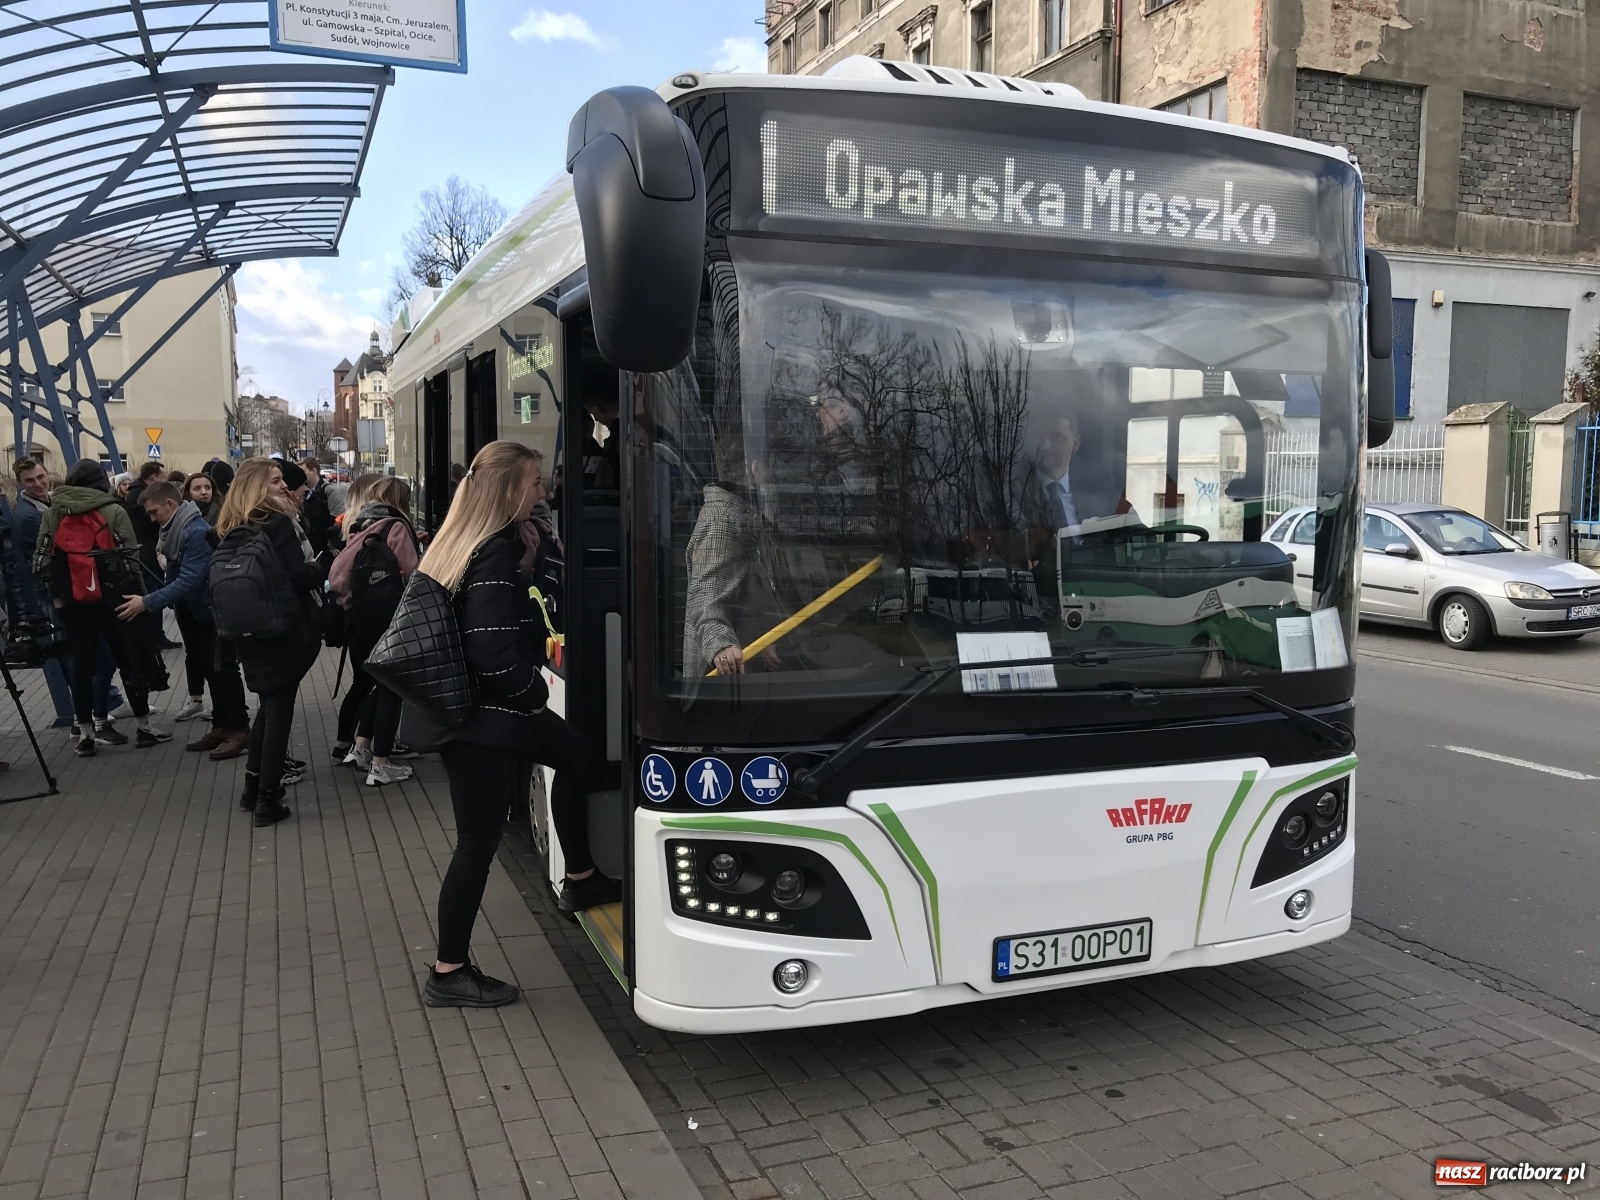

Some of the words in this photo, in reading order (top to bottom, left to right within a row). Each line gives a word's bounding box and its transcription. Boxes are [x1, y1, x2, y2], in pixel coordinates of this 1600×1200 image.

[286, 3, 297, 11] Pl.
[300, 5, 351, 19] Konstytucji
[361, 13, 384, 24] maja,
[386, 16, 402, 25] Cm.
[405, 19, 451, 32] Jeruzalem,
[302, 18, 313, 26] ul.
[316, 20, 365, 33] Gamowska
[375, 27, 407, 39] Szpital,
[409, 31, 436, 42] Ocice,
[331, 34, 359, 45] Sudół,
[361, 38, 410, 50] Wojnowice
[826, 138, 1065, 227] Opawska
[1083, 165, 1276, 245] Mieszko
[1125, 833, 1154, 843] GRUPA
[1157, 832, 1174, 841] PBG
[998, 961, 1008, 970] PL
[1014, 937, 1059, 970] S31
[1071, 925, 1145, 962] 00P01
